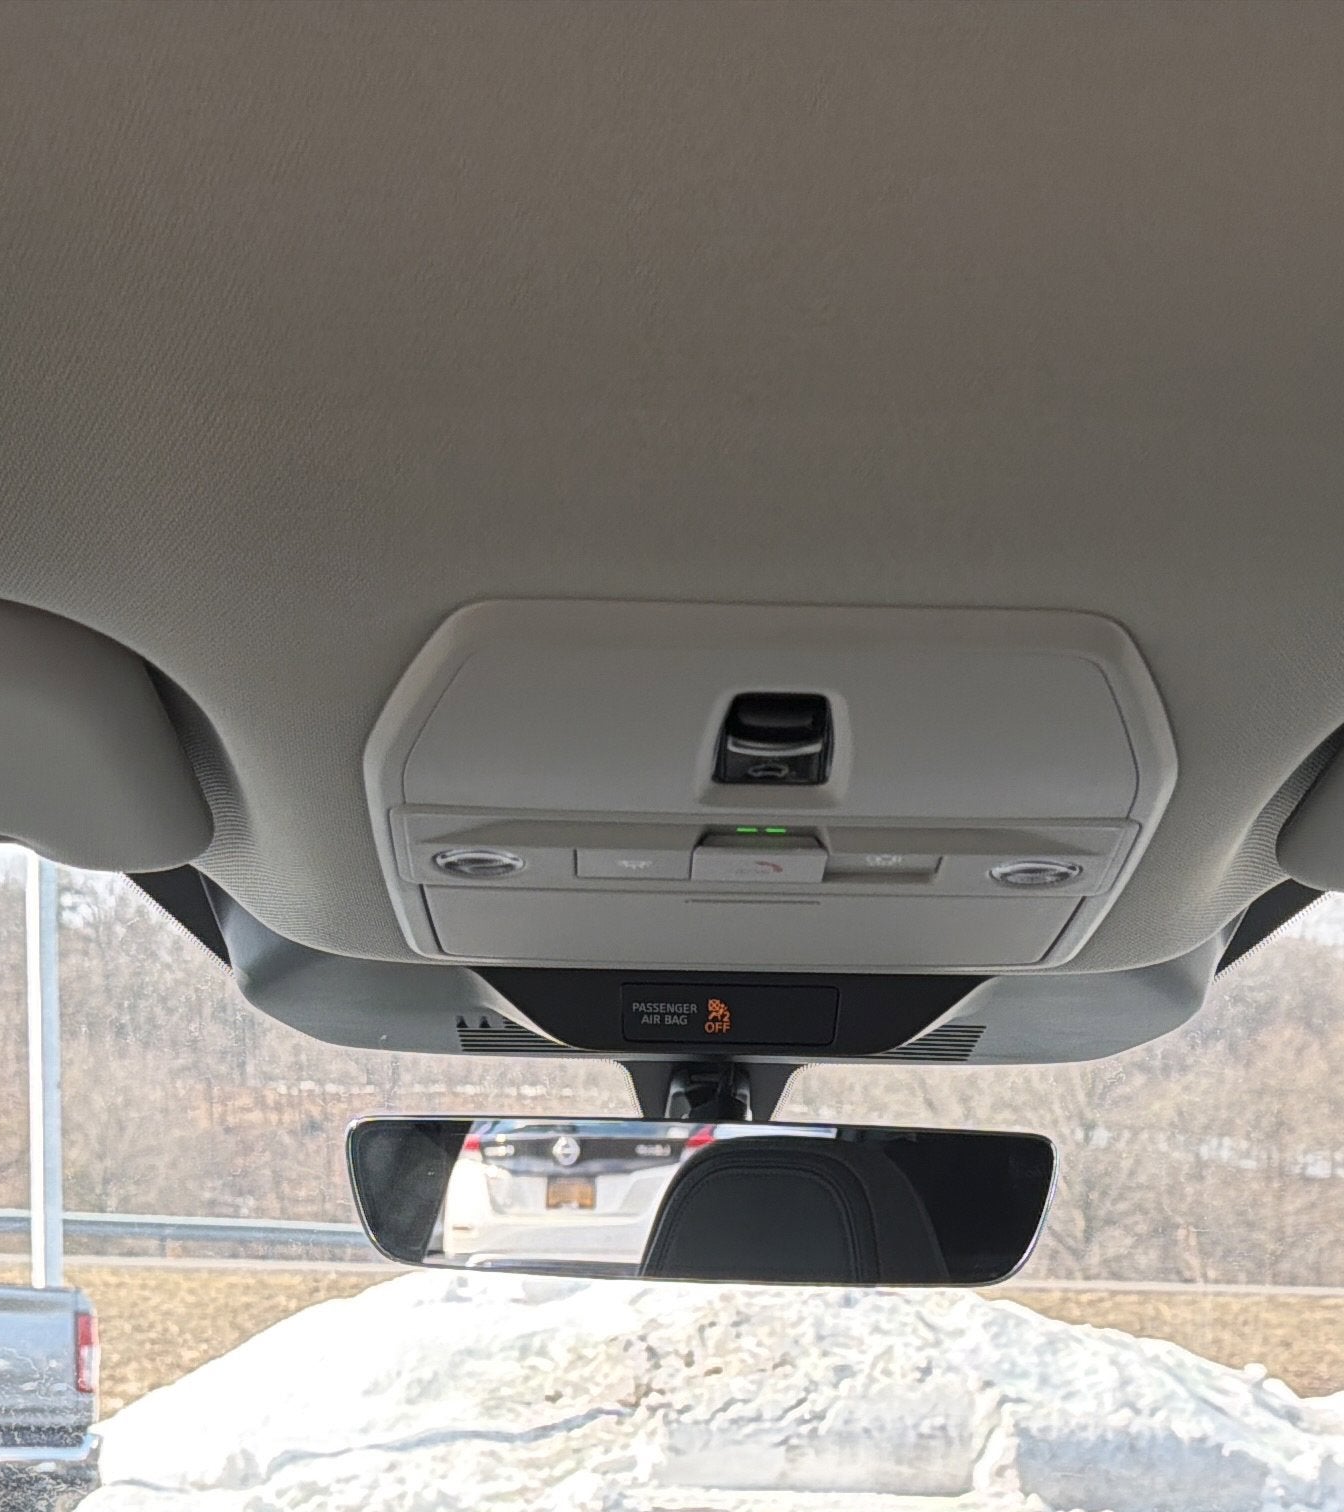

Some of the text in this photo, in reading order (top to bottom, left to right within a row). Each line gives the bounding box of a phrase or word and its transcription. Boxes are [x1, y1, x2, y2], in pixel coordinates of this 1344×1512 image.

[632, 1003, 697, 1014] PASSENGER
[641, 1015, 687, 1025] AIR BAG
[705, 1022, 730, 1033] OFF
